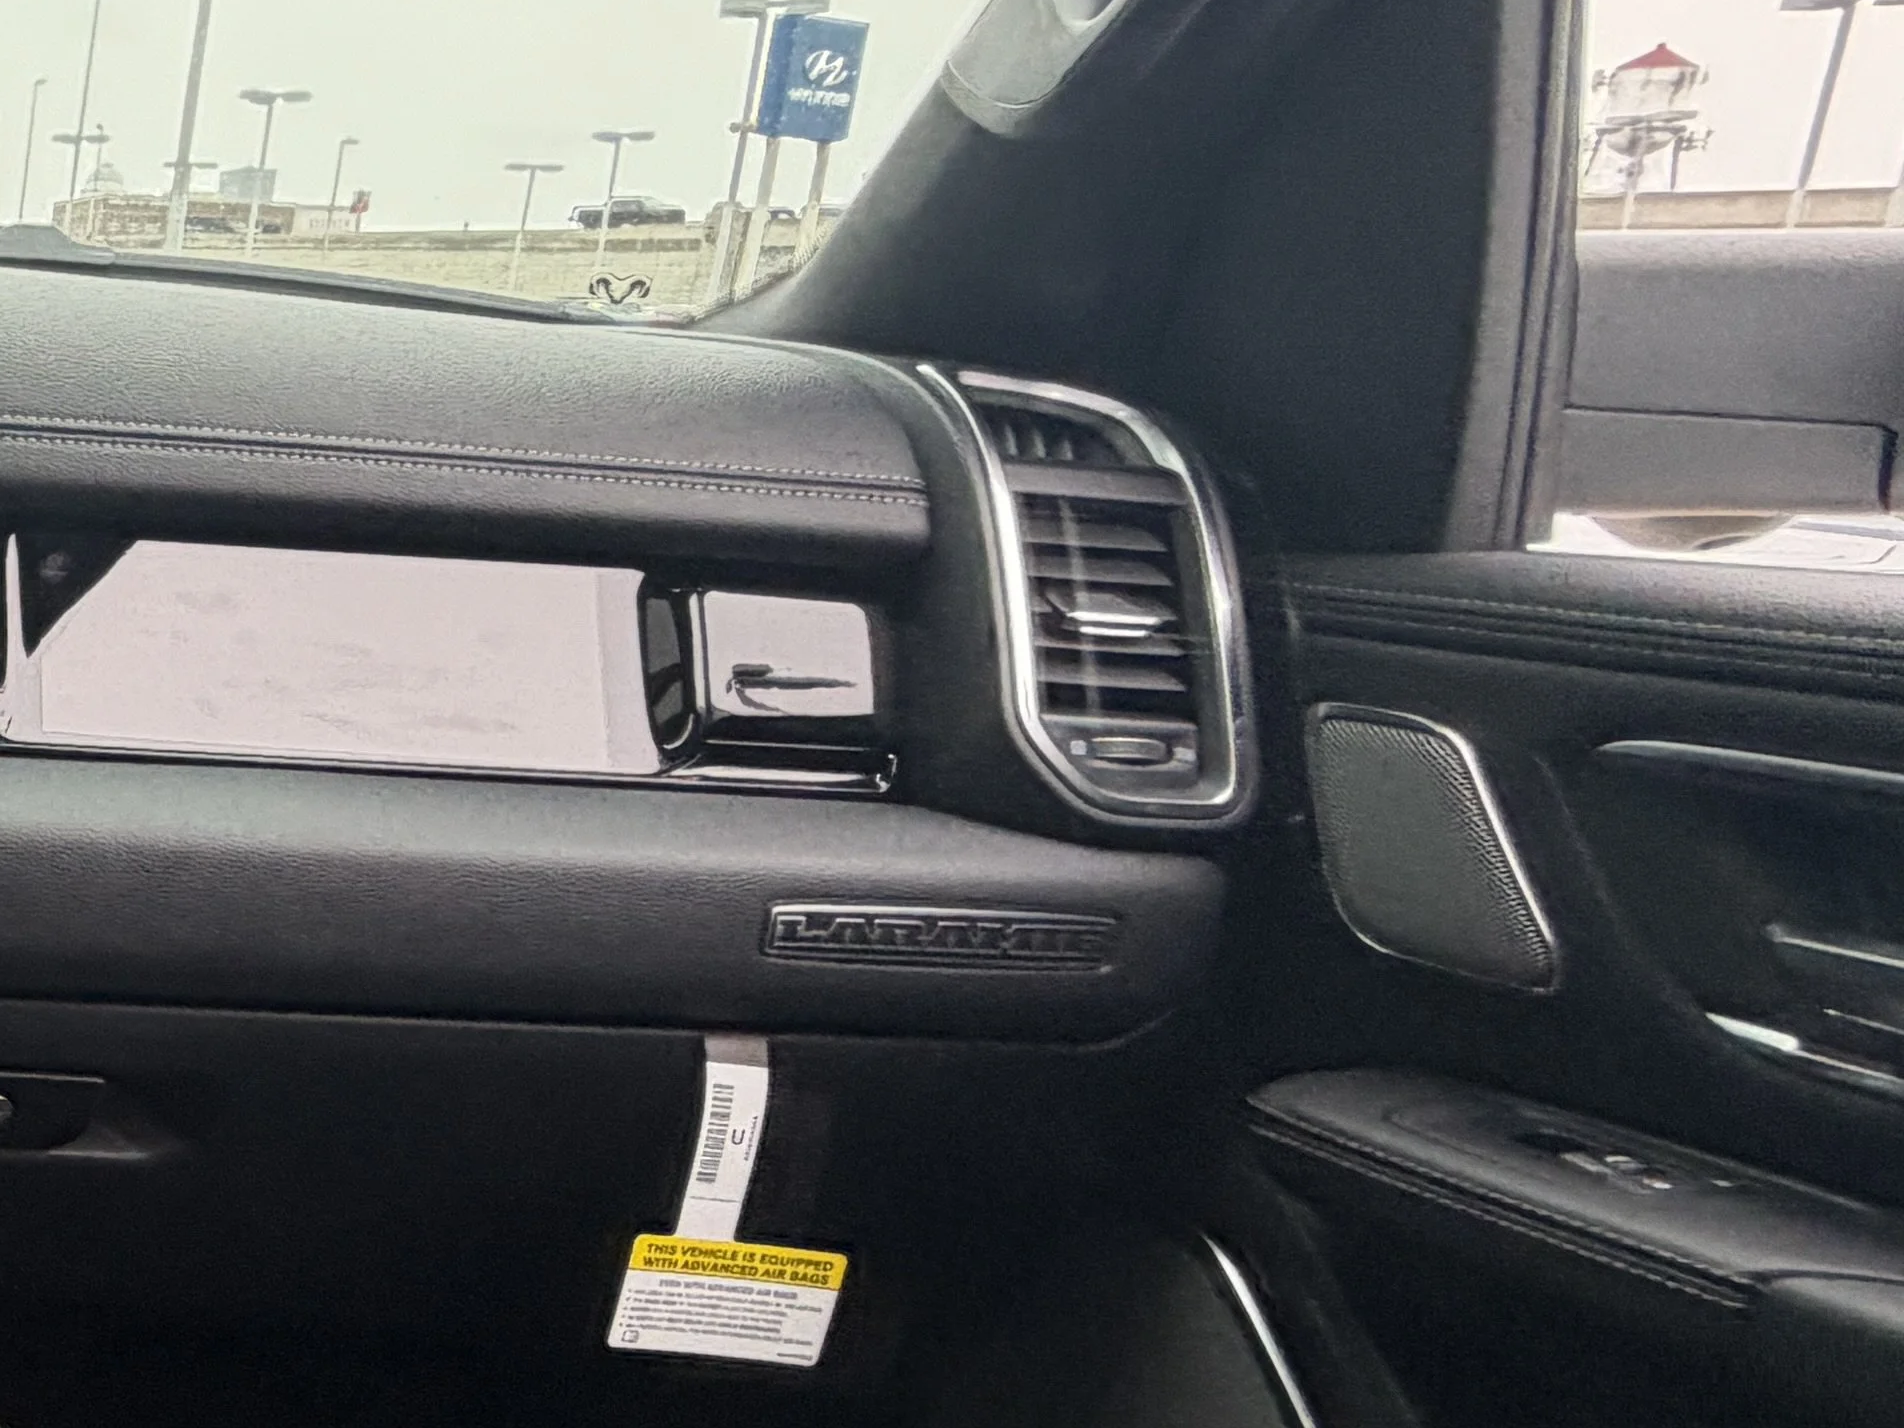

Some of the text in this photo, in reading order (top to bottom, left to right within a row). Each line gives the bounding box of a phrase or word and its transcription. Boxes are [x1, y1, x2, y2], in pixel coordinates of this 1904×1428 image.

[643, 1257, 831, 1285] WITH ADVANCED AIR BAGS
[647, 1243, 834, 1272] THIS VEHICLE IS EQUIPPED
